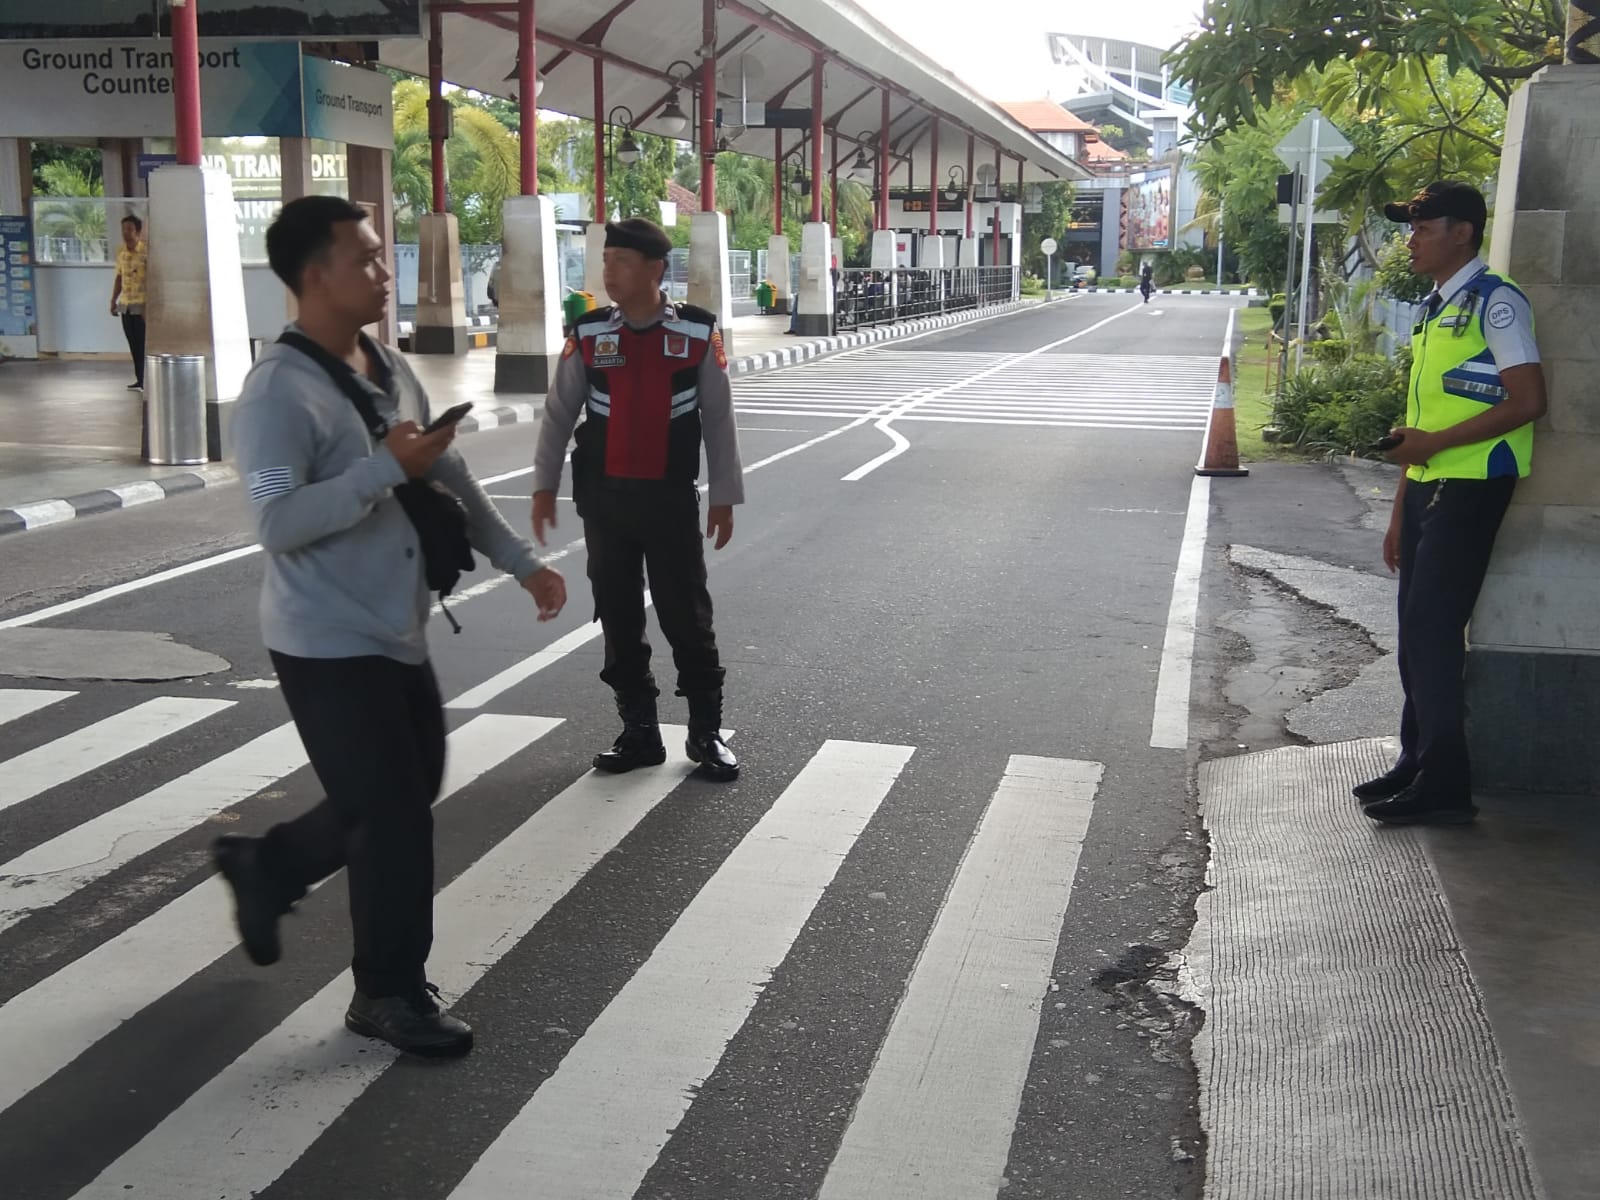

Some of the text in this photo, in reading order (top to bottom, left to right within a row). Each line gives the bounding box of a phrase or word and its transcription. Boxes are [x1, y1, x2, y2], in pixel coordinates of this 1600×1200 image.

[22, 47, 241, 70] Ground Tranort
[315, 88, 383, 118] Ground Transport
